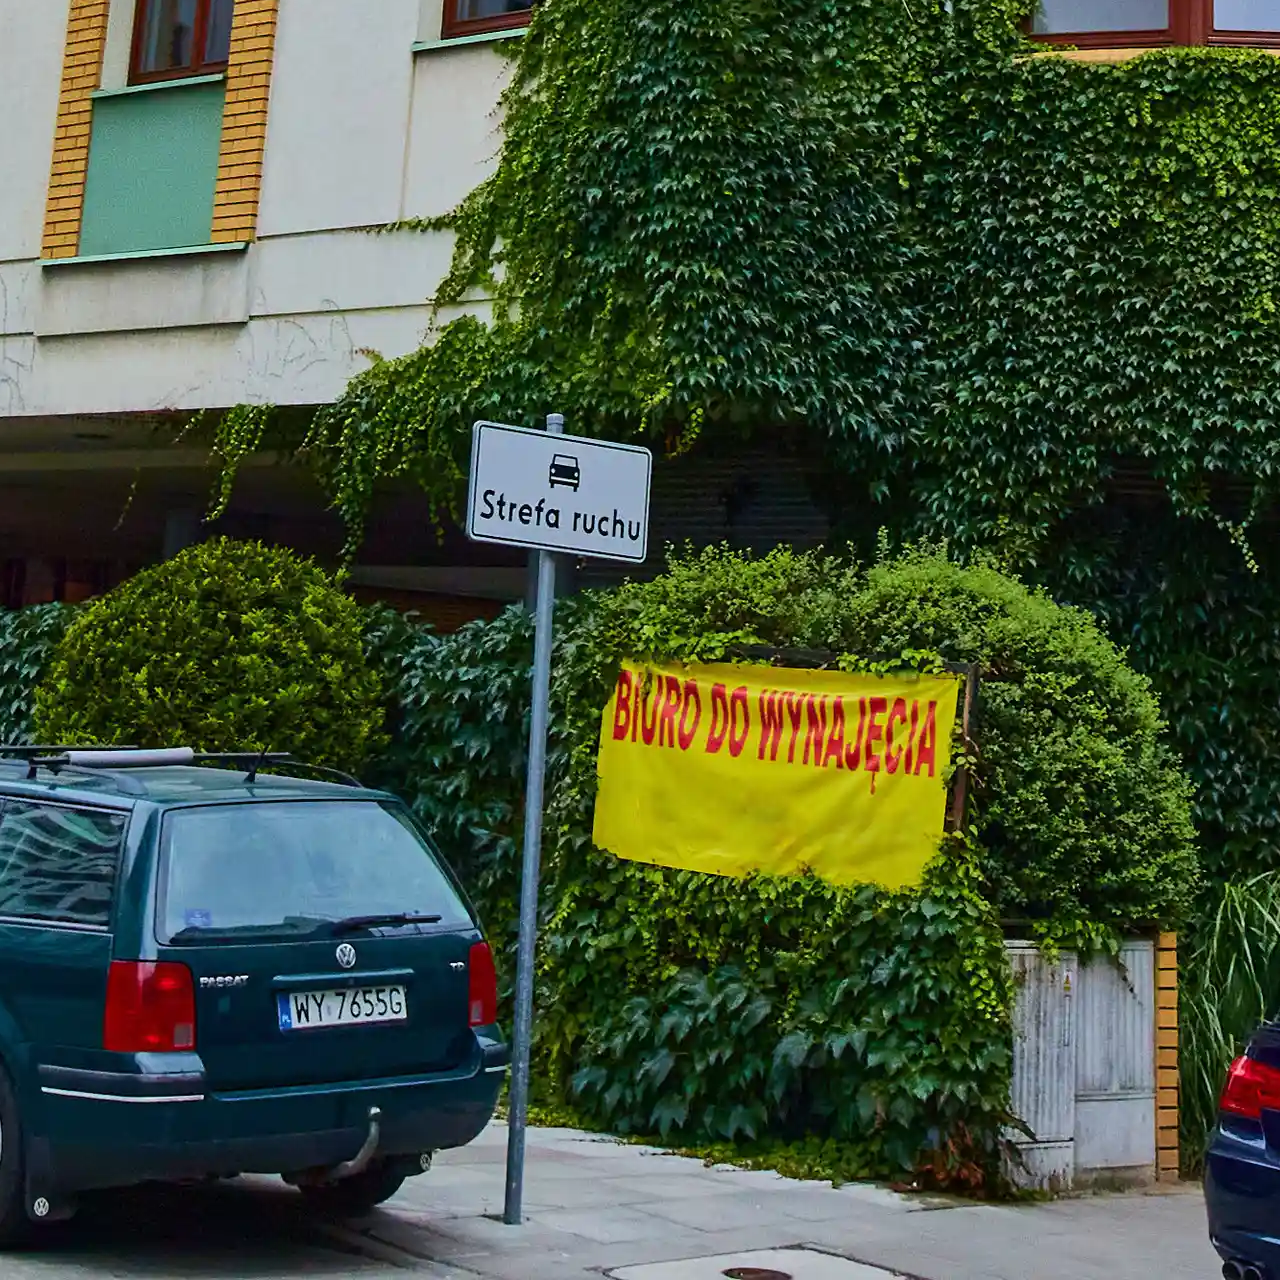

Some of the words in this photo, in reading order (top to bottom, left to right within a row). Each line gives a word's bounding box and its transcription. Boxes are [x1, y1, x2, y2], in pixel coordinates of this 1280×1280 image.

[480, 489, 560, 529] Strefa
[572, 509, 640, 541] ruchu
[612, 669, 702, 751] BIURO
[705, 683, 750, 757] DO
[757, 688, 937, 795] WYNAJĘCIA
[199, 975, 249, 988] PASSAT
[294, 993, 325, 1024] WY
[335, 988, 402, 1019] 7655G
